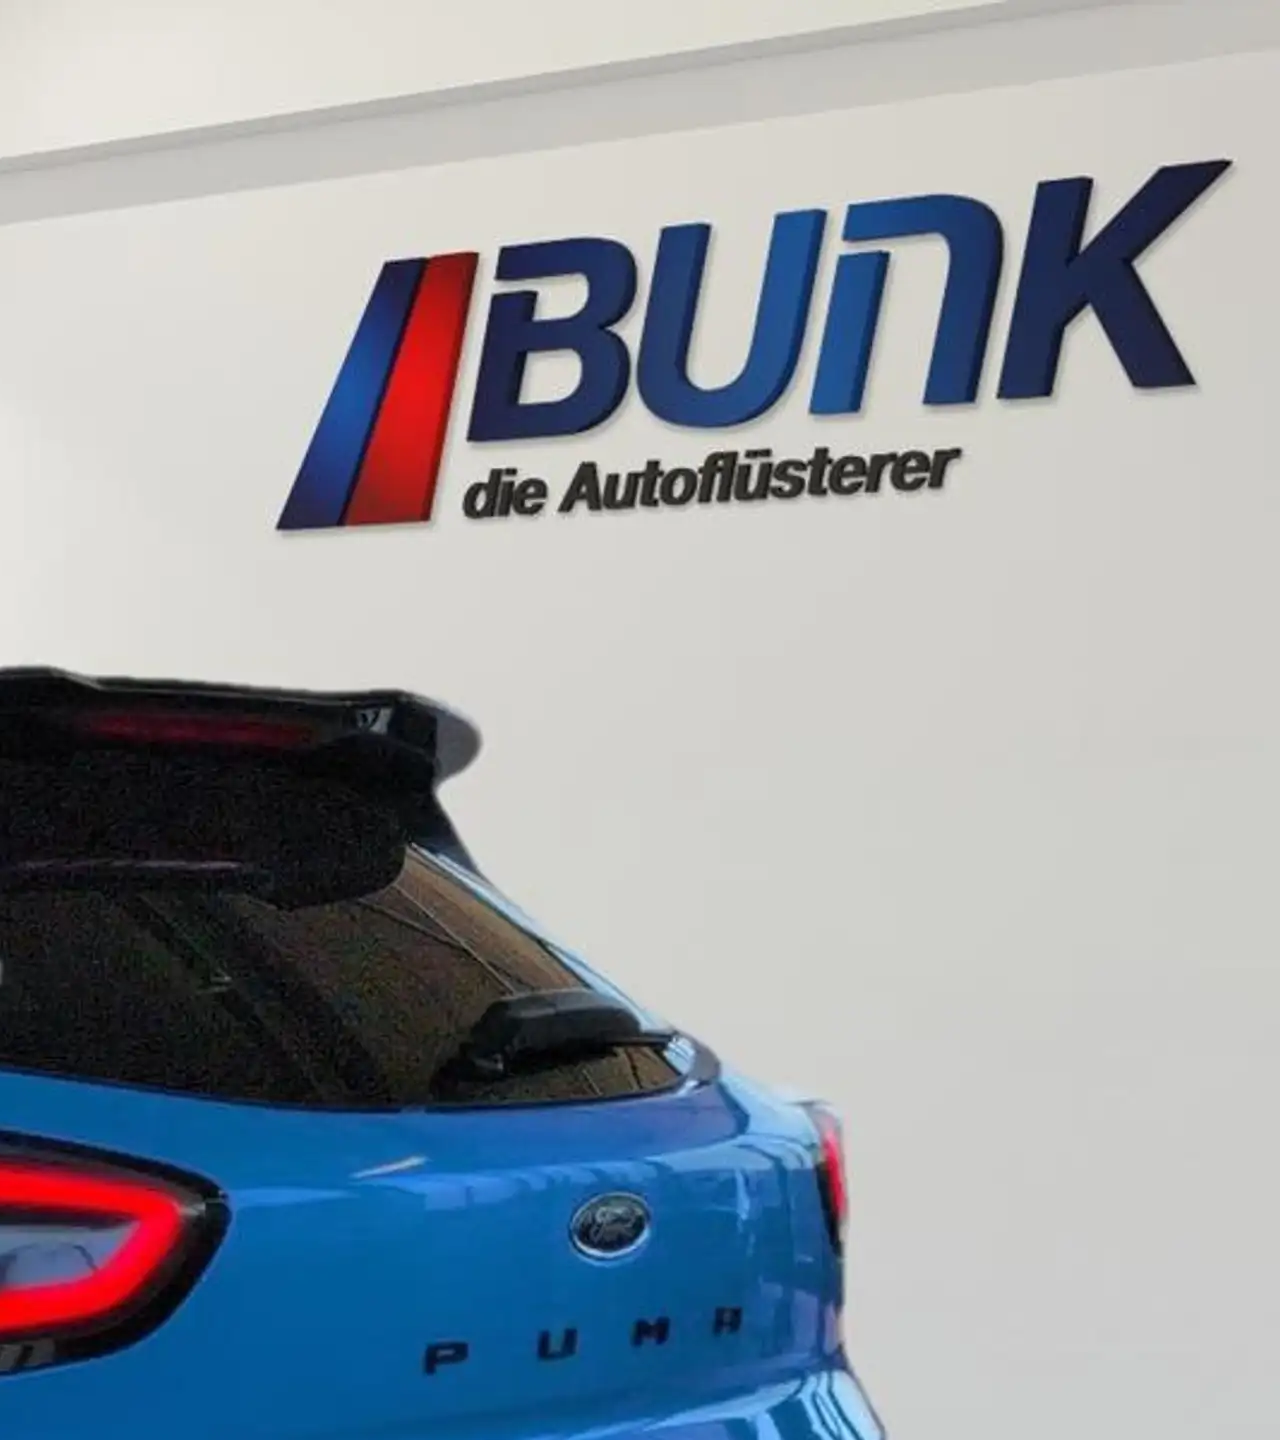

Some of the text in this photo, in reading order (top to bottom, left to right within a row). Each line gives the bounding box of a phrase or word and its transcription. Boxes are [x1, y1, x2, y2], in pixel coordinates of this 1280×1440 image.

[467, 159, 1233, 440] BUNK
[463, 447, 962, 518] die Autoflüsterer
[423, 1306, 743, 1374] PUMA
